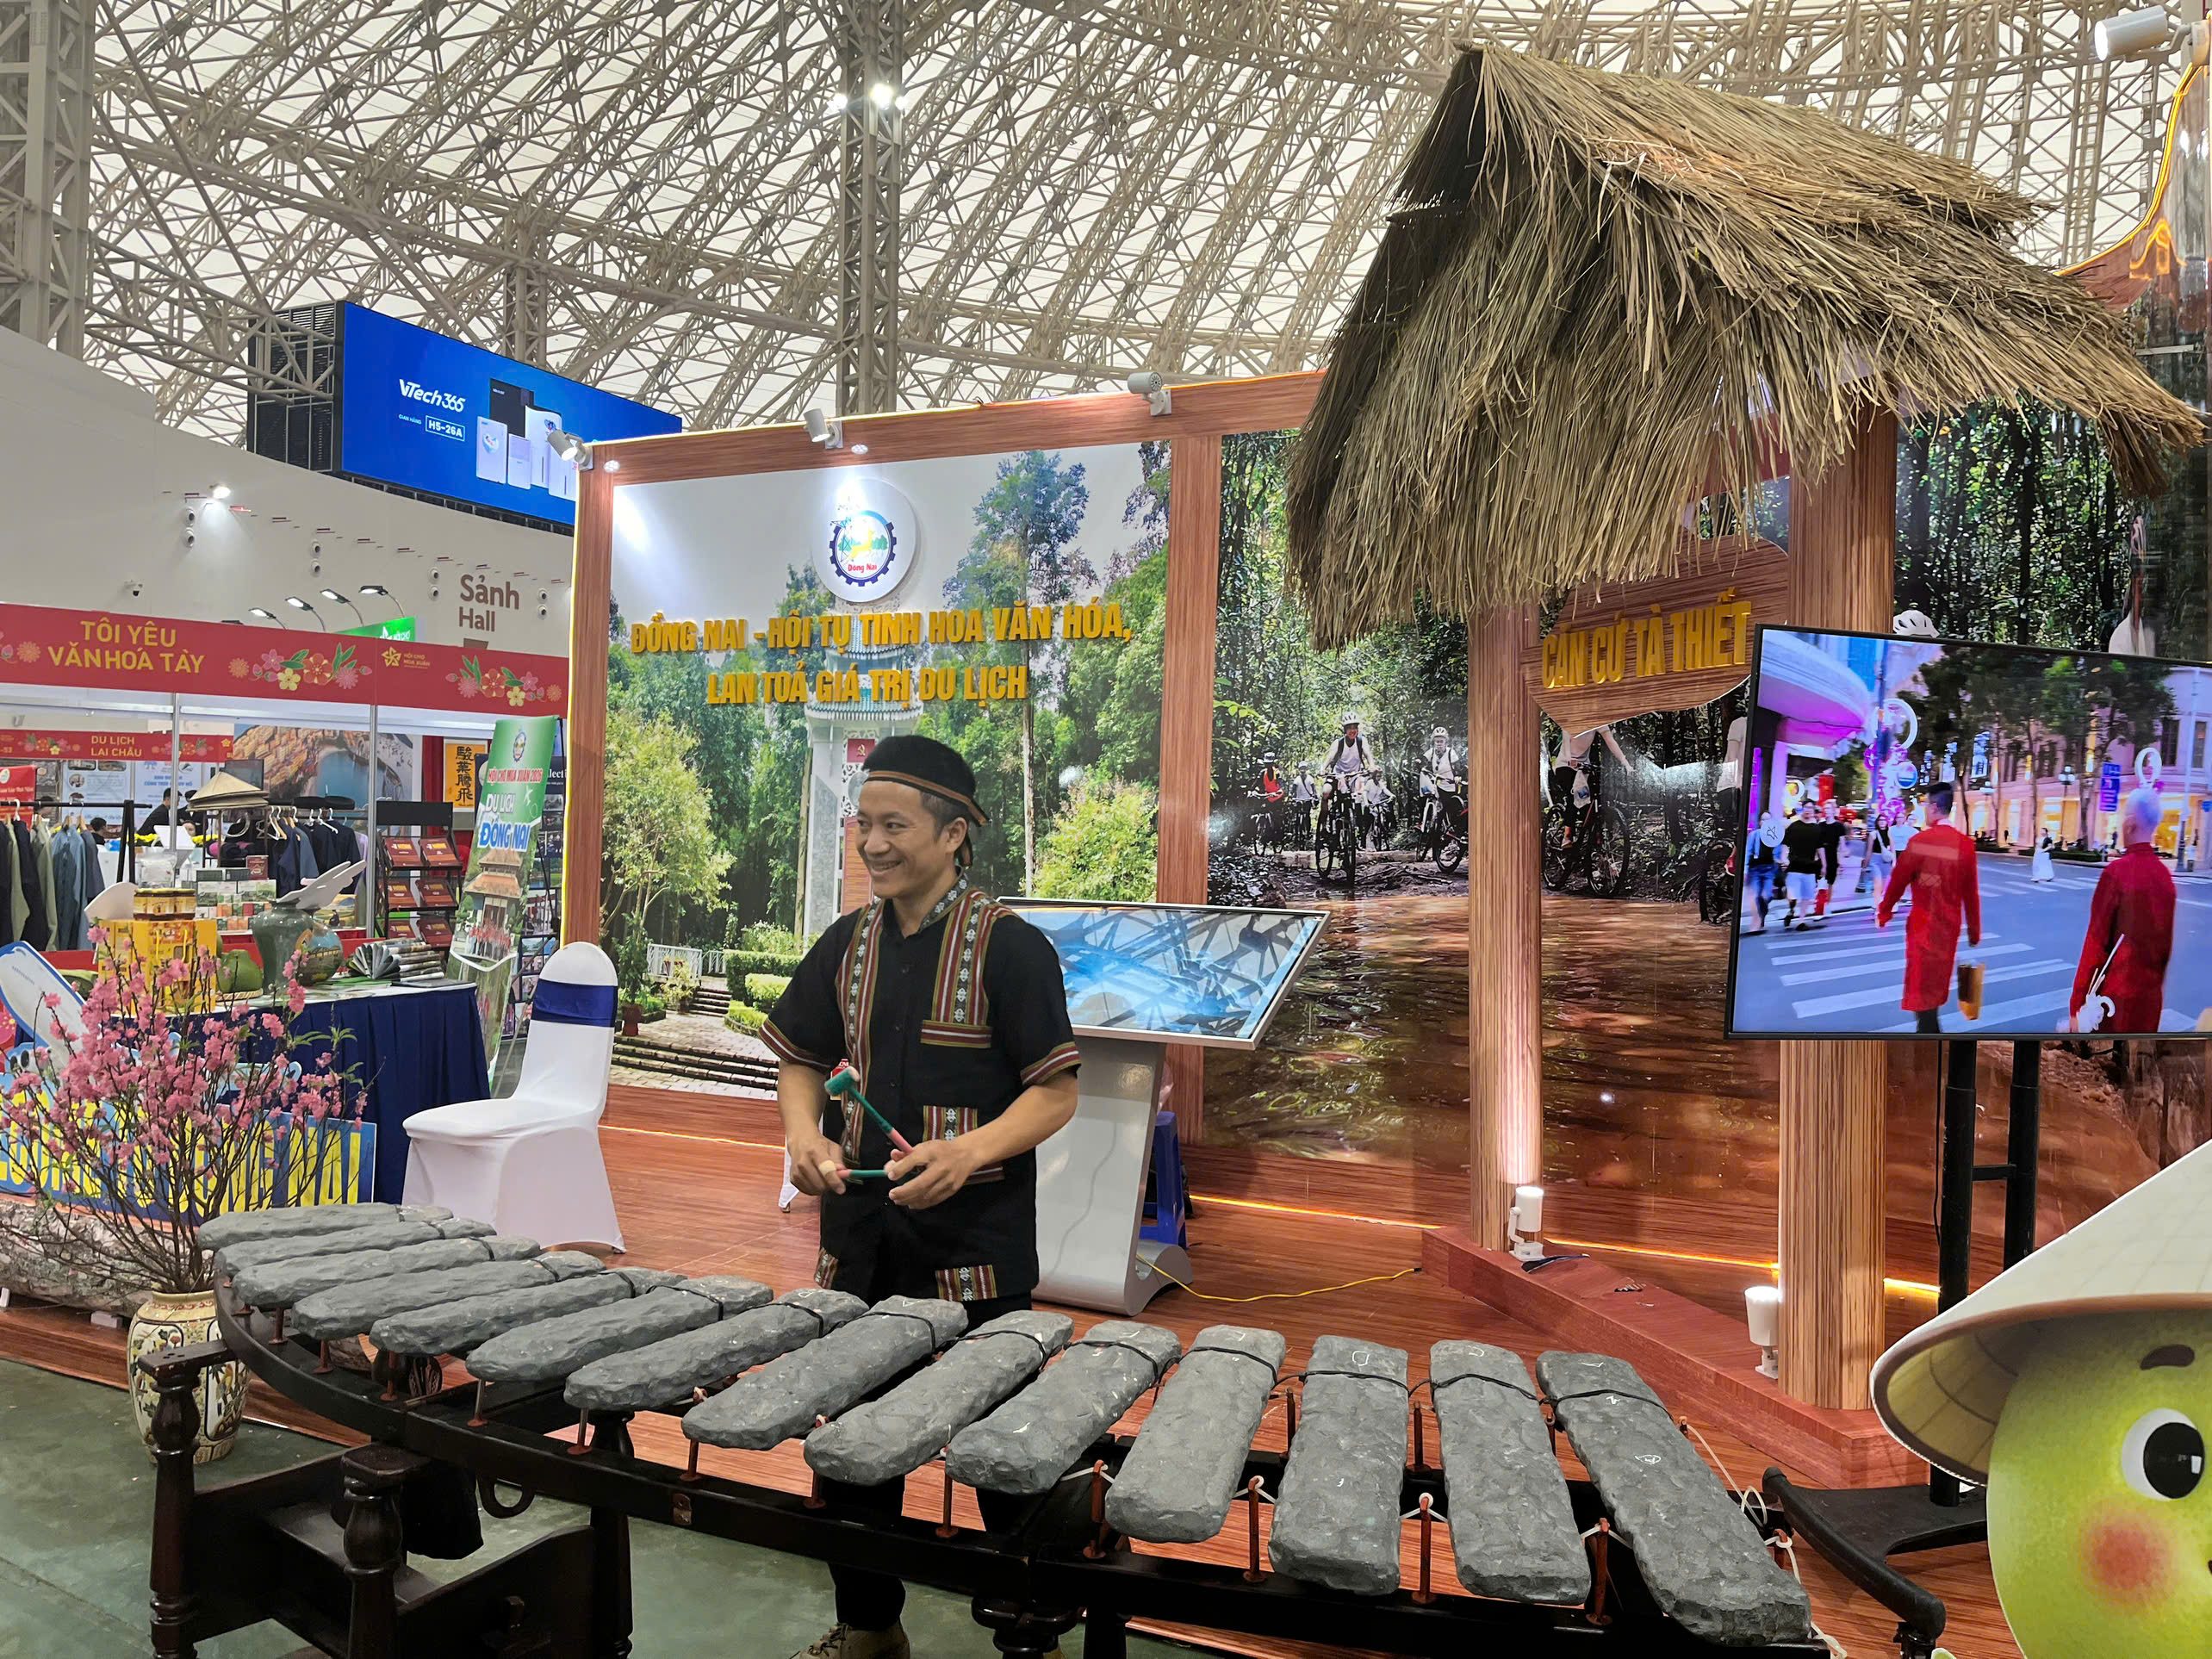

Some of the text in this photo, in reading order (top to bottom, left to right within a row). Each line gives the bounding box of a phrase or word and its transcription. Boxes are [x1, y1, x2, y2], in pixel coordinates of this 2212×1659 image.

[428, 419, 463, 438] H5-26A
[460, 574, 520, 610] Sảnh
[458, 606, 496, 632] Hall
[631, 612, 697, 654] ĐỒNG
[702, 618, 746, 651] NAI
[819, 614, 853, 655] TỤ
[860, 612, 922, 646] TINH
[928, 610, 985, 643] HOA
[993, 600, 1057, 641] VĂN
[1669, 586, 1752, 673] THIẾT
[80, 617, 177, 648] TÔI YÊU
[159, 649, 206, 674] TÀY
[707, 672, 756, 705] LAN
[815, 662, 861, 703] GIÁ
[868, 668, 912, 709] TRỊ
[919, 668, 956, 700] DU
[964, 665, 1030, 708] LỊCH
[90, 735, 135, 746] DU LỊCH
[90, 745, 142, 757] LAI CHÂU
[485, 793, 498, 813] DU
[512, 824, 531, 850] NAI
[287, 1124, 362, 1207] NAI
